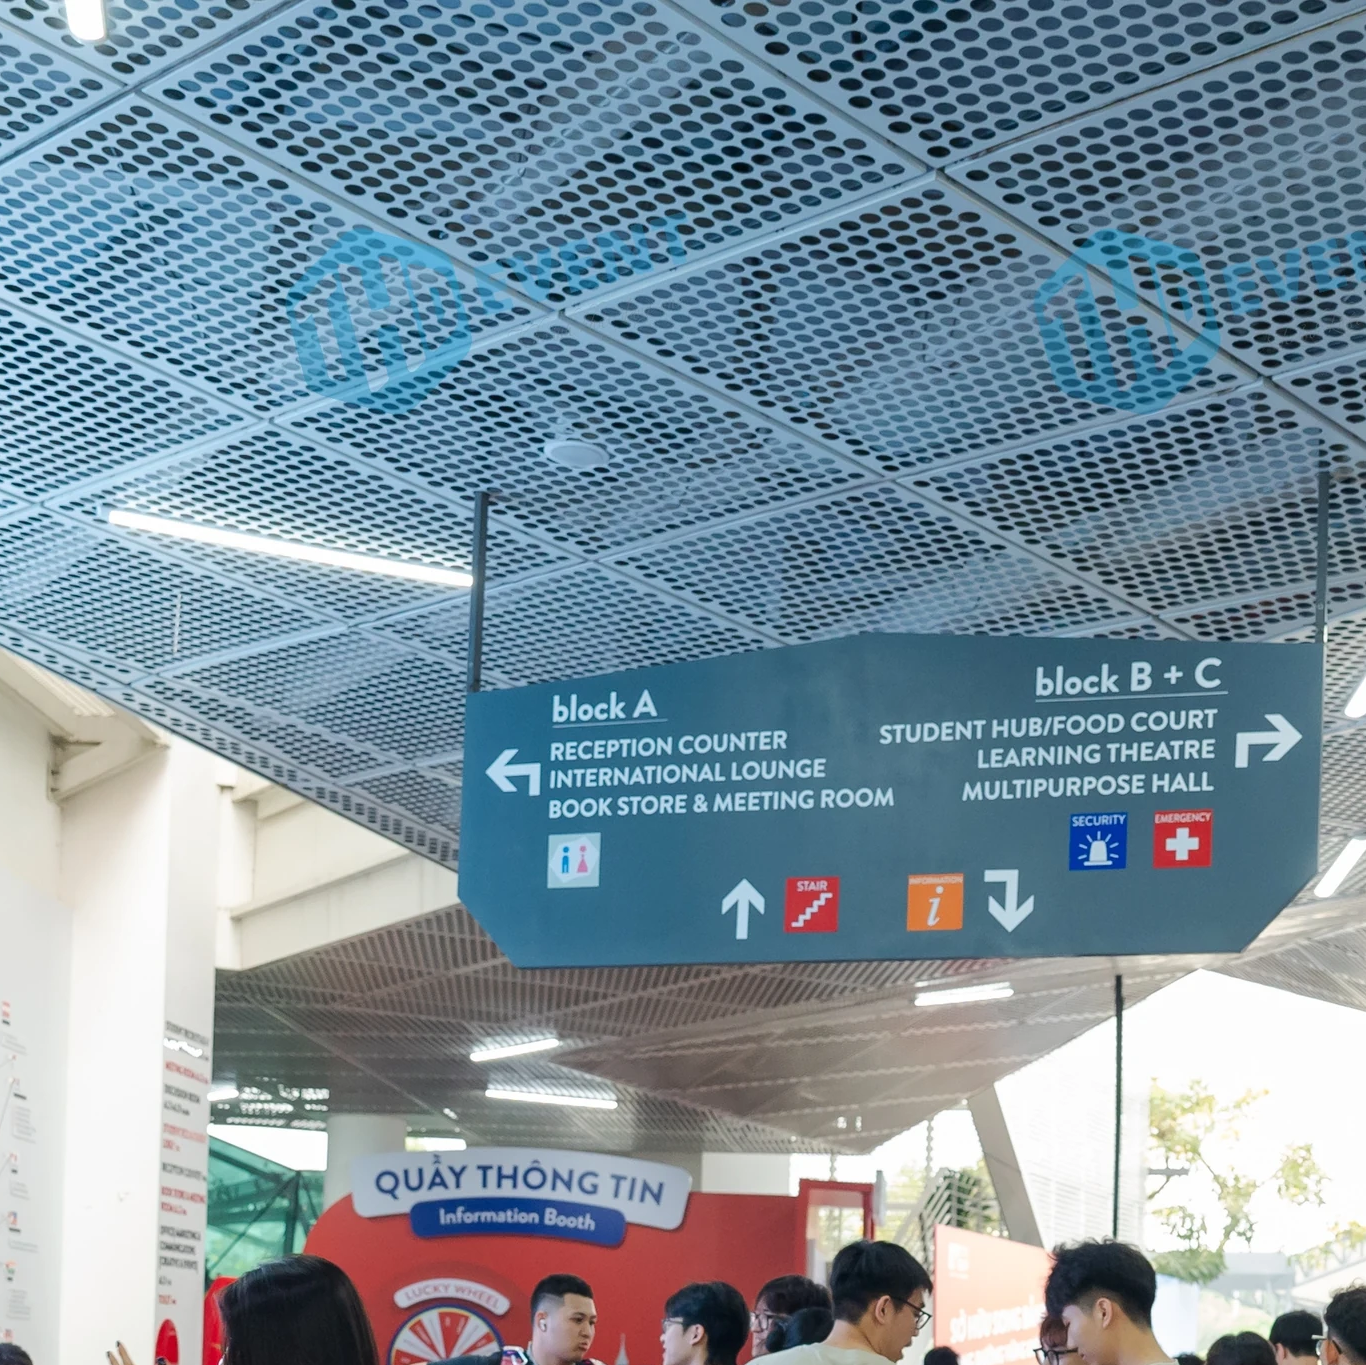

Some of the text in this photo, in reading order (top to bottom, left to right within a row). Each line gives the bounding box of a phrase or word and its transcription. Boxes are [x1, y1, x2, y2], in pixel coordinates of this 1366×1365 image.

[1036, 663, 1119, 696] block
[1130, 661, 1152, 692] B
[1194, 657, 1222, 689] C
[552, 689, 657, 722] block A
[879, 708, 1218, 745] STUDENT HUB/FOOD COURT
[550, 730, 787, 761] RECEPTION COUNTER
[977, 739, 1215, 769] LEARNING THEATRE
[549, 758, 826, 789] INTERNATIONAL LOUNGE
[962, 772, 1214, 801] MULTIPURPOSE HALL
[549, 787, 894, 819] BOOK STORE & MEETING ROOM
[1154, 812, 1212, 824] EMERGENCY
[1072, 814, 1126, 827] SECURITY
[797, 880, 827, 892] STAIR
[375, 1154, 665, 1205] QUẦY THÔNG TIN
[439, 1206, 596, 1231] Information Booth
[404, 1284, 500, 1309] LUCKY WHEEL
